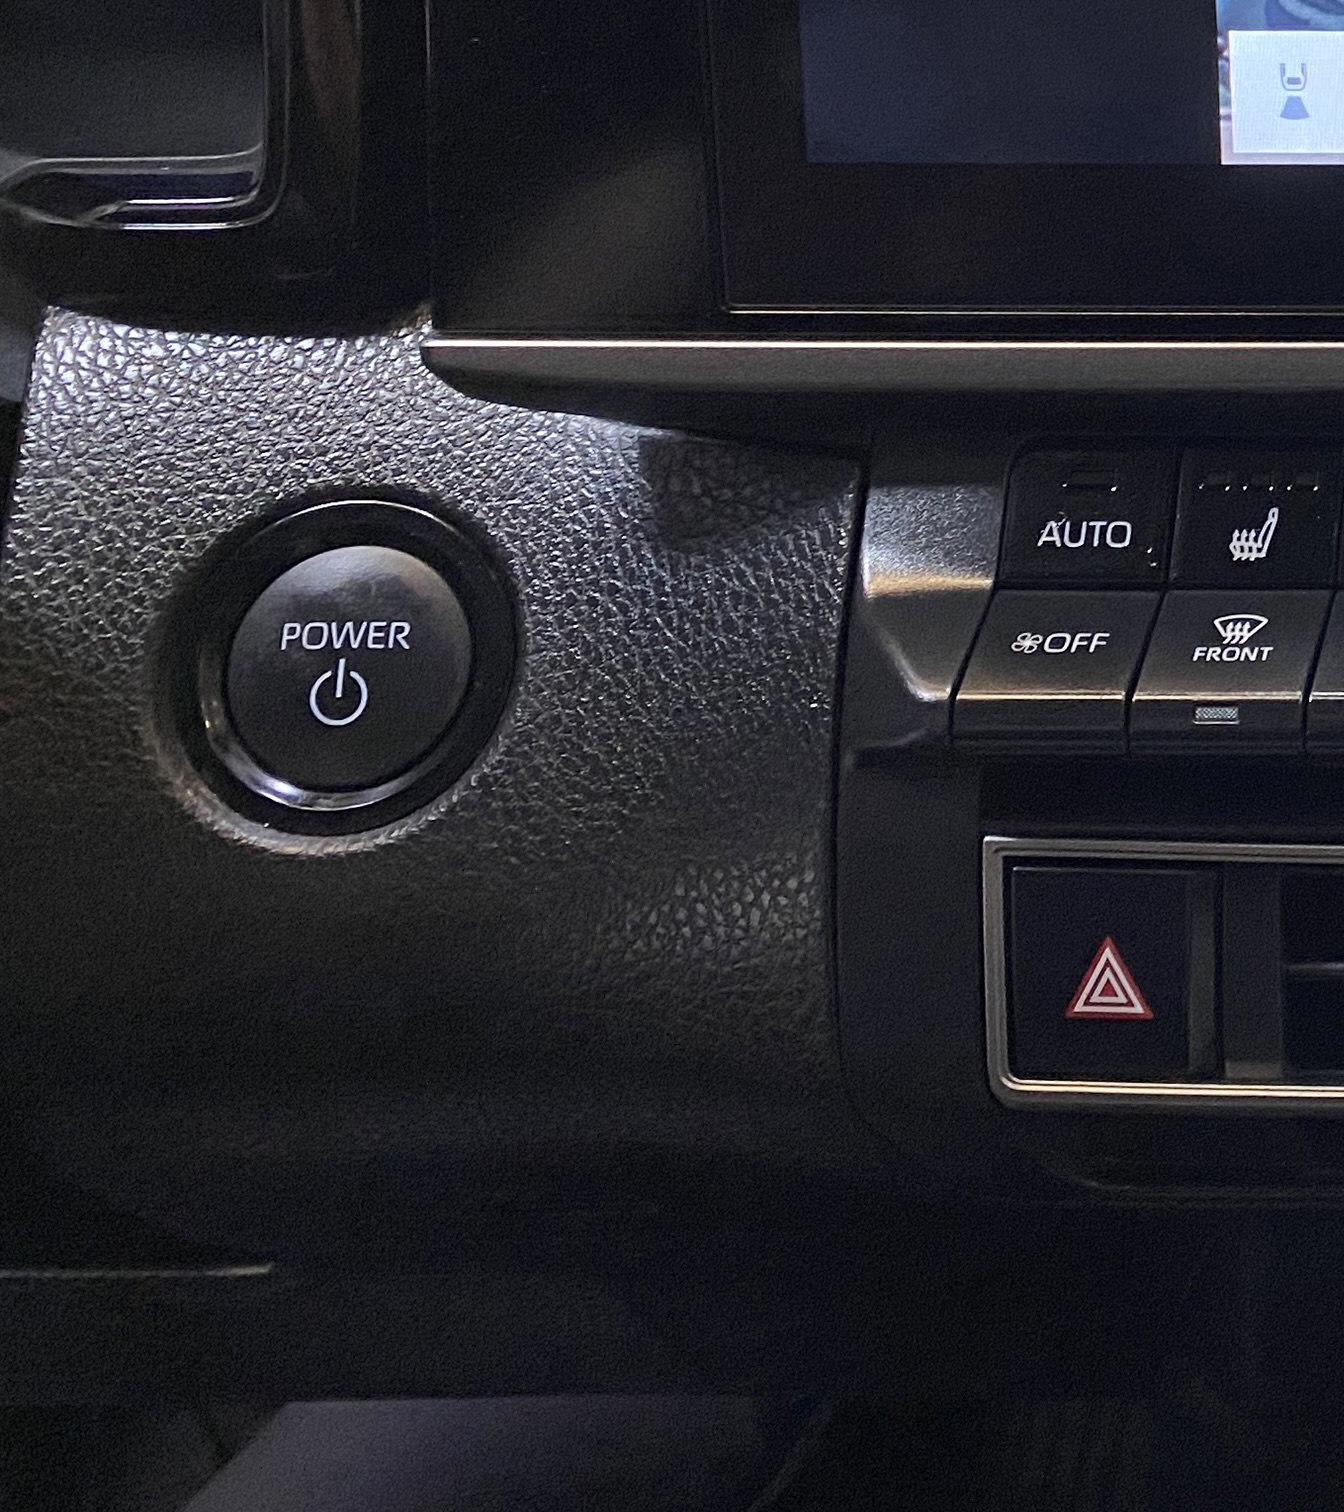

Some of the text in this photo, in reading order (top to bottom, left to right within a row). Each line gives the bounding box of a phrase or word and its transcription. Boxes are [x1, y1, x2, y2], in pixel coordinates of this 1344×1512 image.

[1036, 520, 1133, 549] AUTO
[279, 620, 412, 650] POWER
[1042, 631, 1110, 655] OFF
[1192, 645, 1274, 663] FRONT
